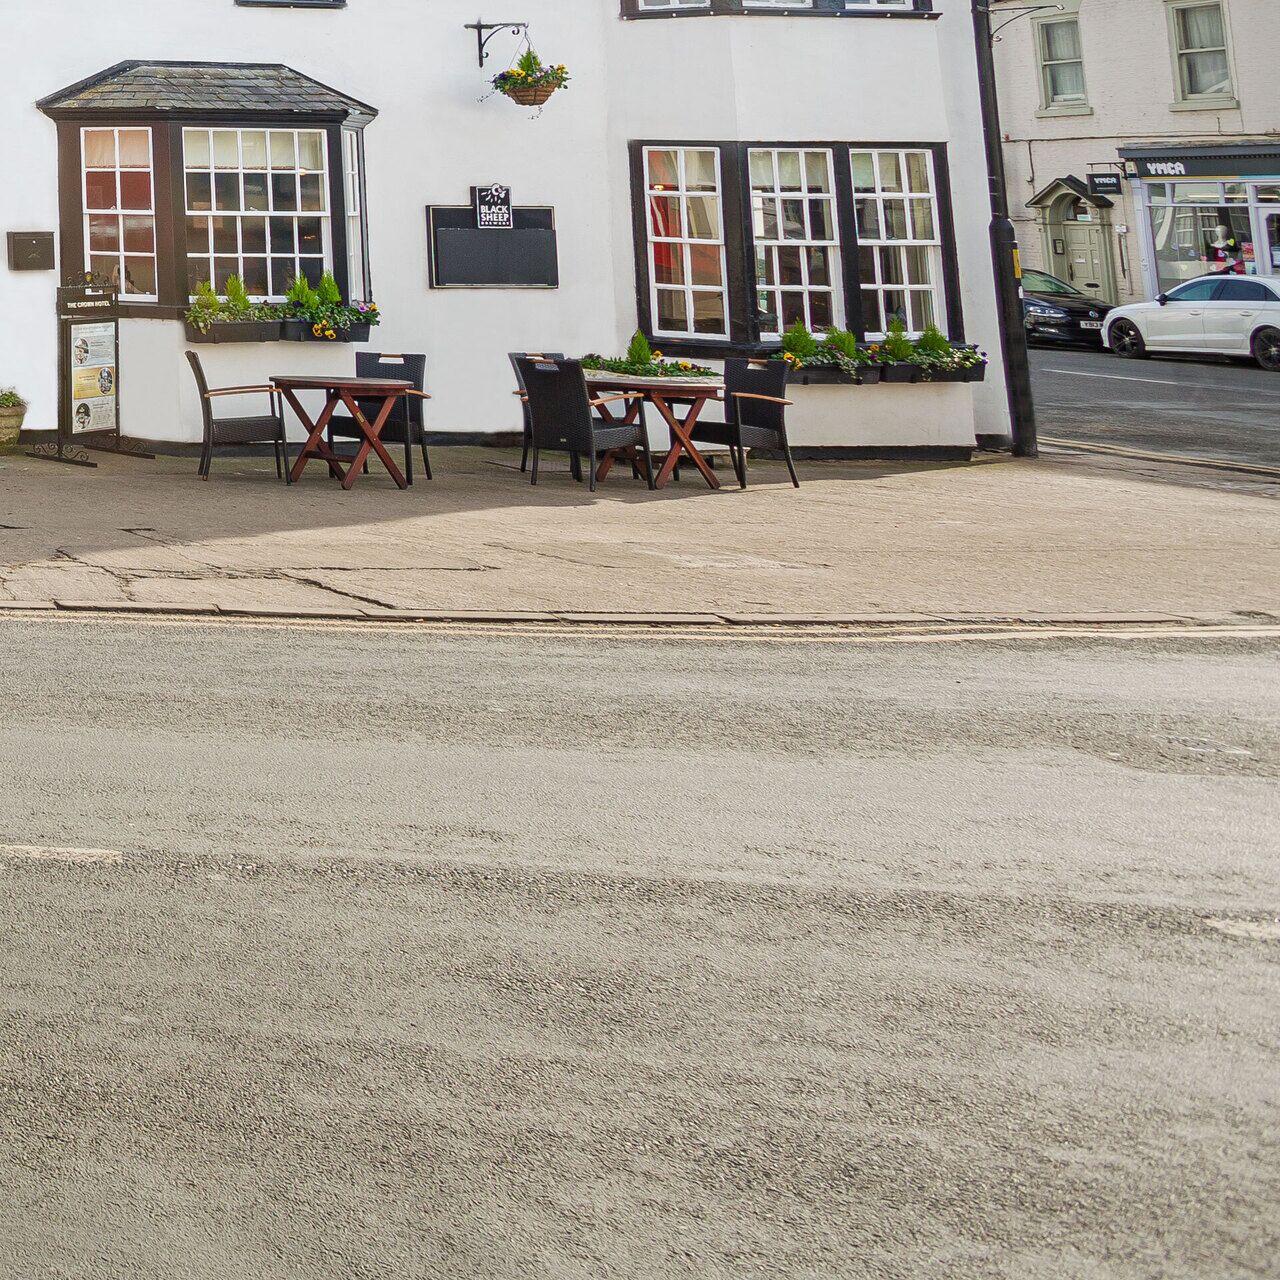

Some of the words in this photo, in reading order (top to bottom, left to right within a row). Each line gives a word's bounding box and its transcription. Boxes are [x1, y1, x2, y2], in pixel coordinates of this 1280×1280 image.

[1146, 162, 1186, 175] YMCA
[480, 205, 509, 214] BLACK
[480, 213, 509, 222] SHEEP
